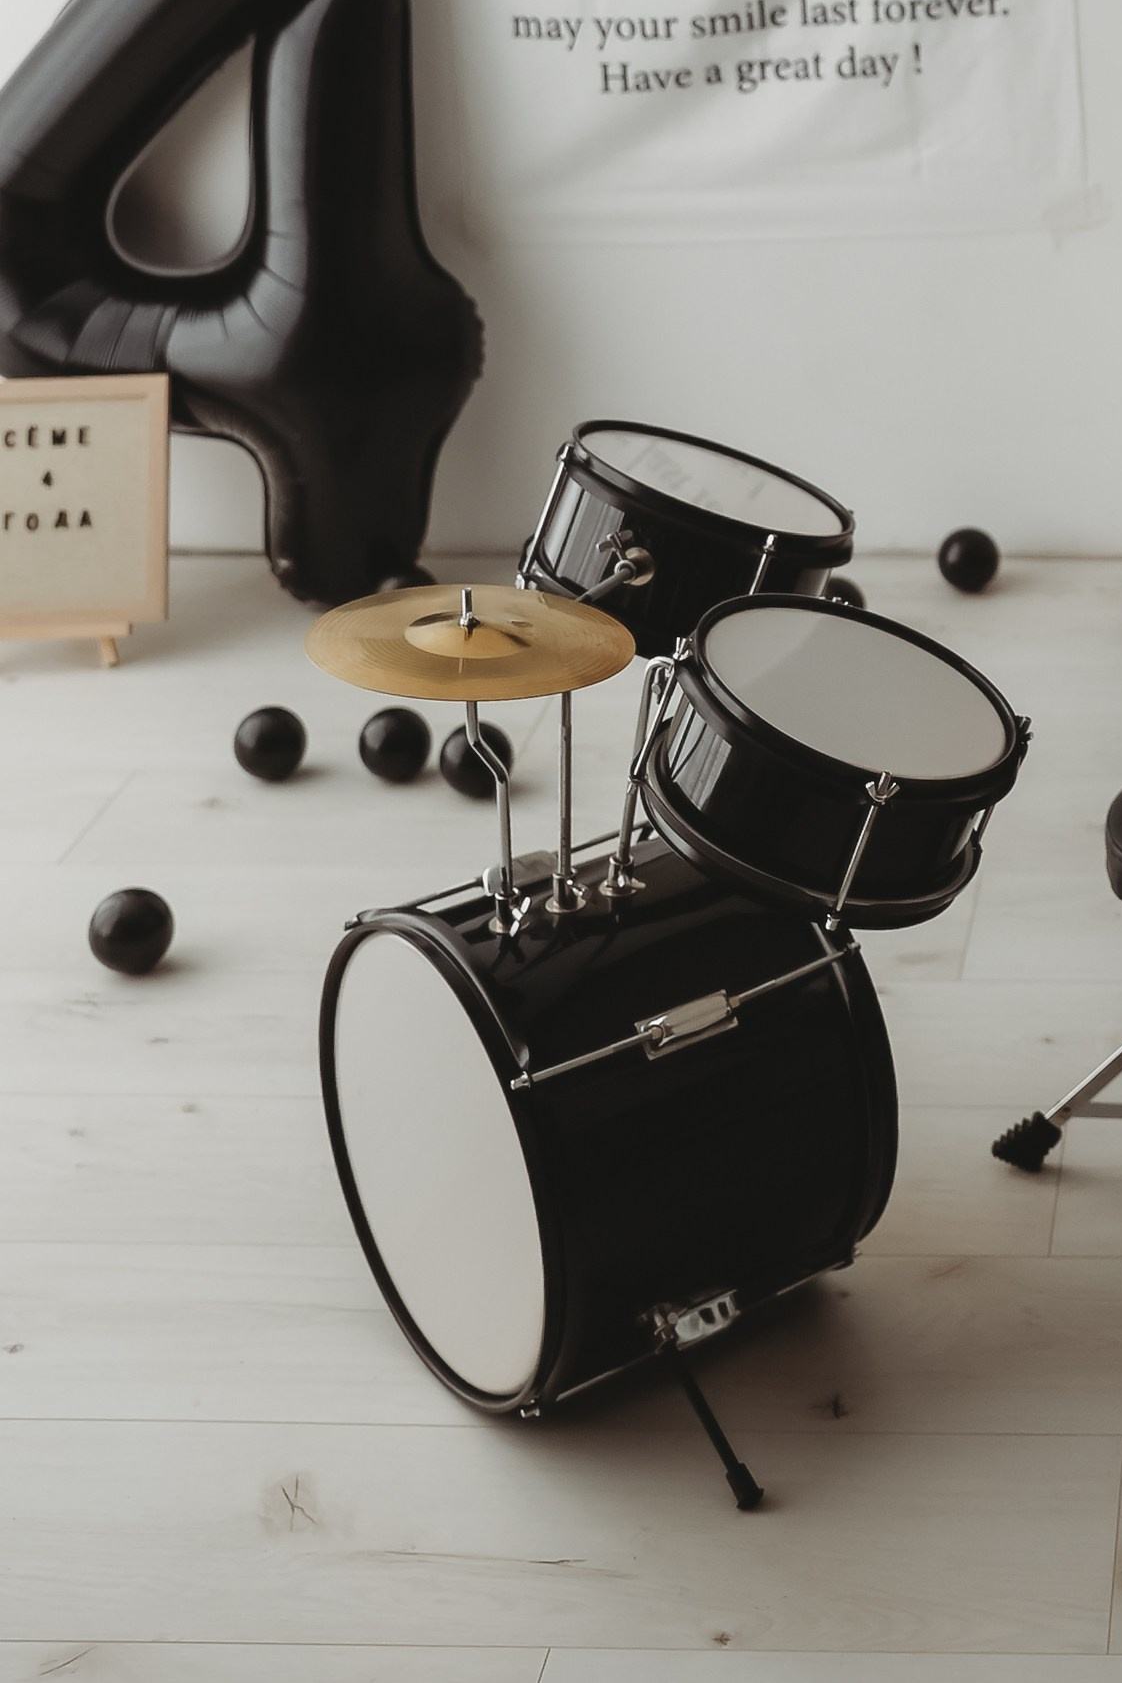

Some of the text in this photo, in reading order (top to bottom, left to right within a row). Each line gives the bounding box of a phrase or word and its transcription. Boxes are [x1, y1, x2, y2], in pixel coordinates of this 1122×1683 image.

[512, 13, 583, 52] may
[592, 17, 679, 51] your
[600, 60, 693, 95] Have
[703, 63, 724, 86] a
[736, 50, 823, 94] great
[836, 44, 899, 88] day
